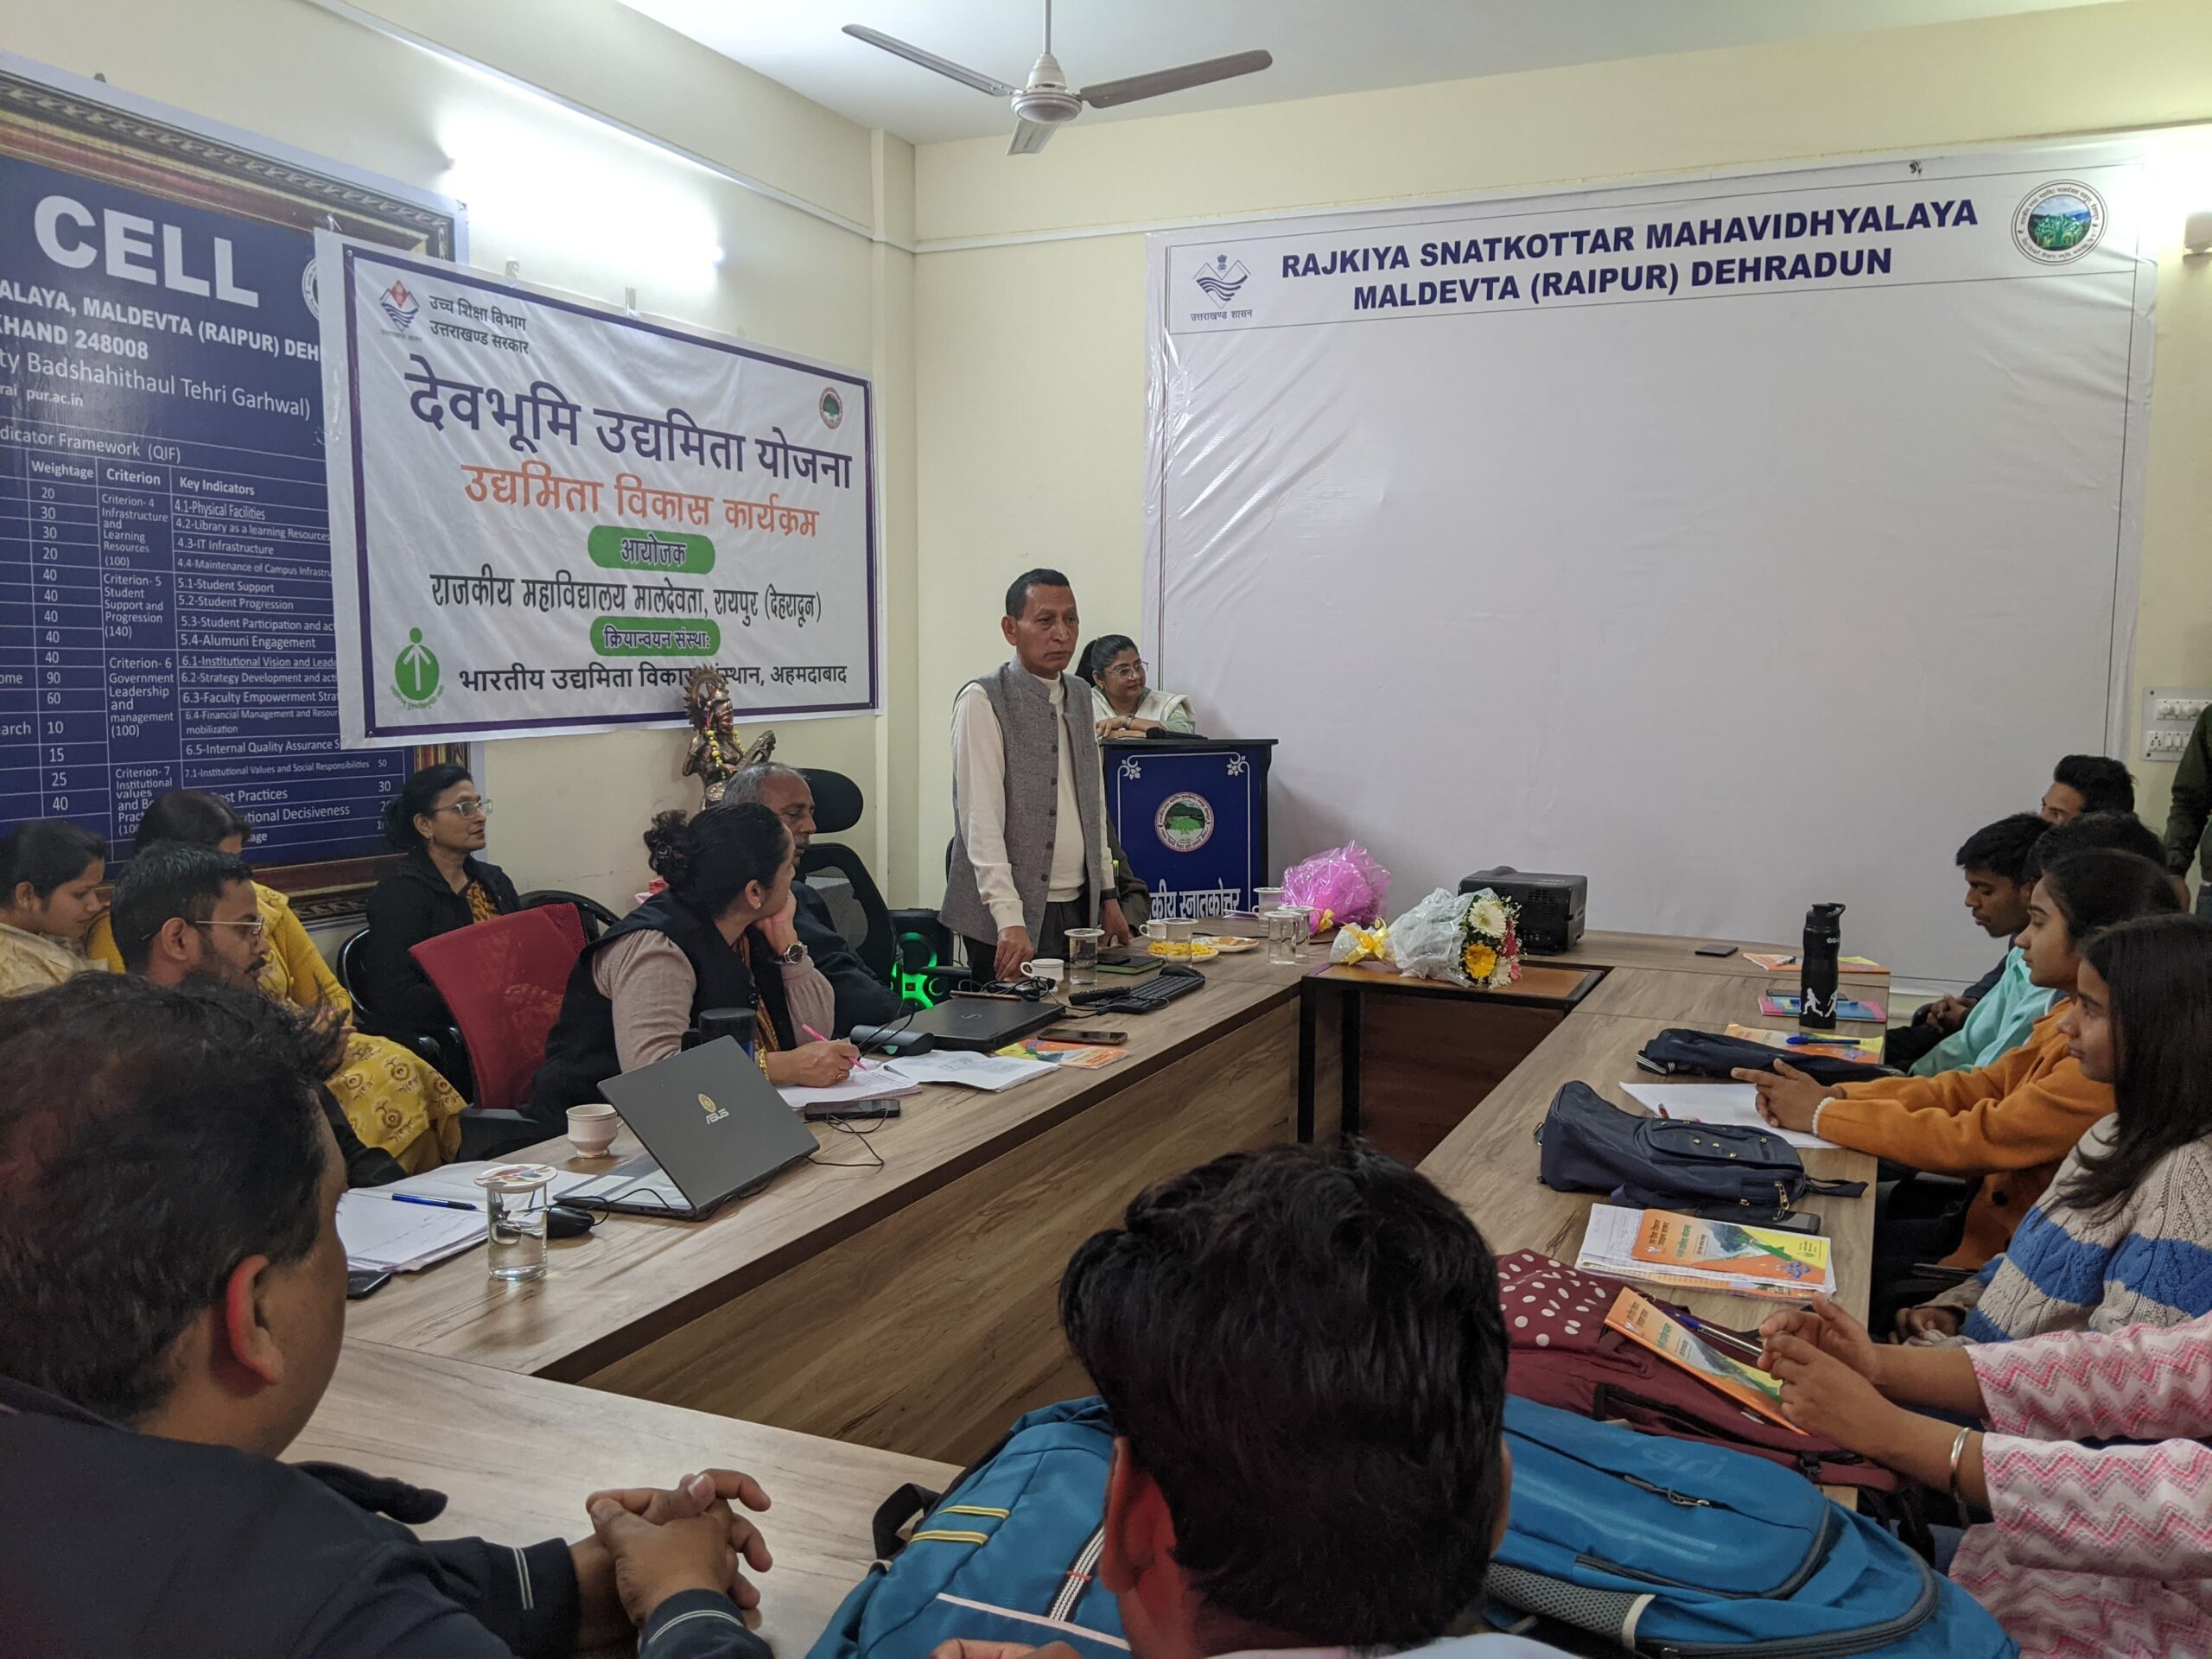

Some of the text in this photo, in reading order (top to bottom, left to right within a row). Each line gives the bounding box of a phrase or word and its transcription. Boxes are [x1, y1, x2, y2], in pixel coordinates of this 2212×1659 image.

[1282, 245, 1407, 278] RAJKIYA
[1420, 226, 1635, 267] SNATKOTTAR
[1646, 198, 1979, 250] MAHAVIDHYALAYA
[35, 195, 259, 308] CELL
[1353, 247, 1892, 311] MALDEVTA (RAIPUR) DEHRADUN
[429, 295, 526, 331] उच्च शिक्षा विभाग
[83, 296, 194, 337] MALDEVTA
[198, 321, 279, 358] (RAIPUR)
[429, 320, 488, 346] उत्तराखण्ड
[492, 335, 529, 354] सरकार
[74, 329, 149, 359] 248008
[28, 352, 175, 395] Badshahithaul
[181, 378, 226, 404] Tehri
[232, 388, 311, 421] Garhwal)
[404, 353, 582, 454] देवभूमि
[593, 408, 746, 472] उद्यमिता
[755, 427, 852, 489] योजना
[59, 433, 141, 456] Framework
[148, 443, 181, 463] (QIF)
[31, 461, 94, 480] Weightage
[106, 467, 161, 486] Criterion
[41, 487, 55, 499] 20
[180, 477, 255, 496] Key Indicators
[148, 498, 155, 508] 4
[461, 460, 819, 537] उद्यमिता विकास कार्यक्रम
[41, 506, 55, 519] 30
[102, 508, 168, 523] Infrastructure
[175, 499, 265, 520] 4.1-Physical Facilities
[103, 518, 122, 529] and
[175, 518, 226, 533] 4.2-Library
[229, 524, 239, 533] as
[241, 525, 247, 534] a
[249, 524, 286, 539] learning
[43, 526, 57, 539] 30
[103, 530, 145, 543] Learning
[104, 541, 149, 553] Resources
[177, 537, 274, 556] 4.3-IT Infrastructure
[621, 533, 687, 564] आयोजक
[43, 547, 58, 560] 20
[105, 556, 130, 568] (100)
[43, 569, 57, 581] 40
[254, 563, 264, 572] of
[264, 563, 297, 576] Campus
[156, 576, 162, 587] 5
[178, 577, 275, 593] 5.1-Student Support
[44, 589, 58, 602] 40
[105, 587, 144, 599] Student
[429, 563, 821, 628] राजकीय महाविद्यालय मालदेवता, रायपुर (देहरादून)
[105, 599, 163, 611] Support and
[178, 595, 294, 611] 5.2-Student Progression
[44, 610, 58, 622] 40
[105, 612, 162, 624] Progression
[181, 616, 240, 628] 5.3-Student
[243, 618, 302, 631] Participation
[304, 619, 321, 630] and
[46, 631, 60, 643] 40
[105, 626, 132, 639] (140)
[604, 626, 671, 648] क्रियान्वयन
[181, 633, 316, 650] 5.4-Alumuni Engagement
[45, 652, 60, 664] 40
[165, 658, 172, 670] 6
[181, 655, 260, 666] 6.1-Institutional
[263, 657, 290, 667] Vision
[294, 657, 310, 667] and
[47, 672, 60, 683] 90
[109, 673, 175, 684] Government
[181, 672, 239, 684] 6.2-Strategy
[242, 673, 302, 685] Development
[304, 673, 321, 683] and
[459, 663, 544, 691] भारतीय
[550, 662, 632, 690] उद्यमिता
[638, 661, 696, 686] विका
[771, 664, 848, 686] अहमदाबाद
[47, 692, 61, 704] 60
[110, 686, 169, 698] Leadership
[183, 692, 241, 704] 6.3-Faculty
[244, 692, 316, 704] Empowerment
[111, 699, 134, 710] and
[111, 712, 174, 724] management
[241, 710, 294, 720] Management
[296, 709, 311, 717] and
[0, 721, 31, 735] arch
[48, 721, 63, 734] 10
[111, 725, 139, 738] (100)
[186, 724, 238, 734] mobilization
[49, 747, 64, 762] 15
[186, 742, 245, 755] 6.5-Internal
[248, 741, 283, 753] Quality
[285, 741, 333, 751] Assurance
[164, 766, 170, 776] 7
[250, 765, 275, 775] Values
[277, 764, 291, 773] and
[293, 763, 314, 772] Social
[315, 760, 370, 772] Responsibilities
[378, 759, 387, 767] 50
[52, 772, 67, 786] 25
[116, 778, 173, 791] Institutional
[116, 789, 152, 799] values
[238, 789, 288, 803] Practices
[378, 781, 391, 792] 30
[53, 797, 68, 810] 40
[118, 798, 138, 811] and
[283, 806, 350, 820] Decisiveness
[246, 832, 268, 843] age
[705, 1108, 729, 1124] ASUS
